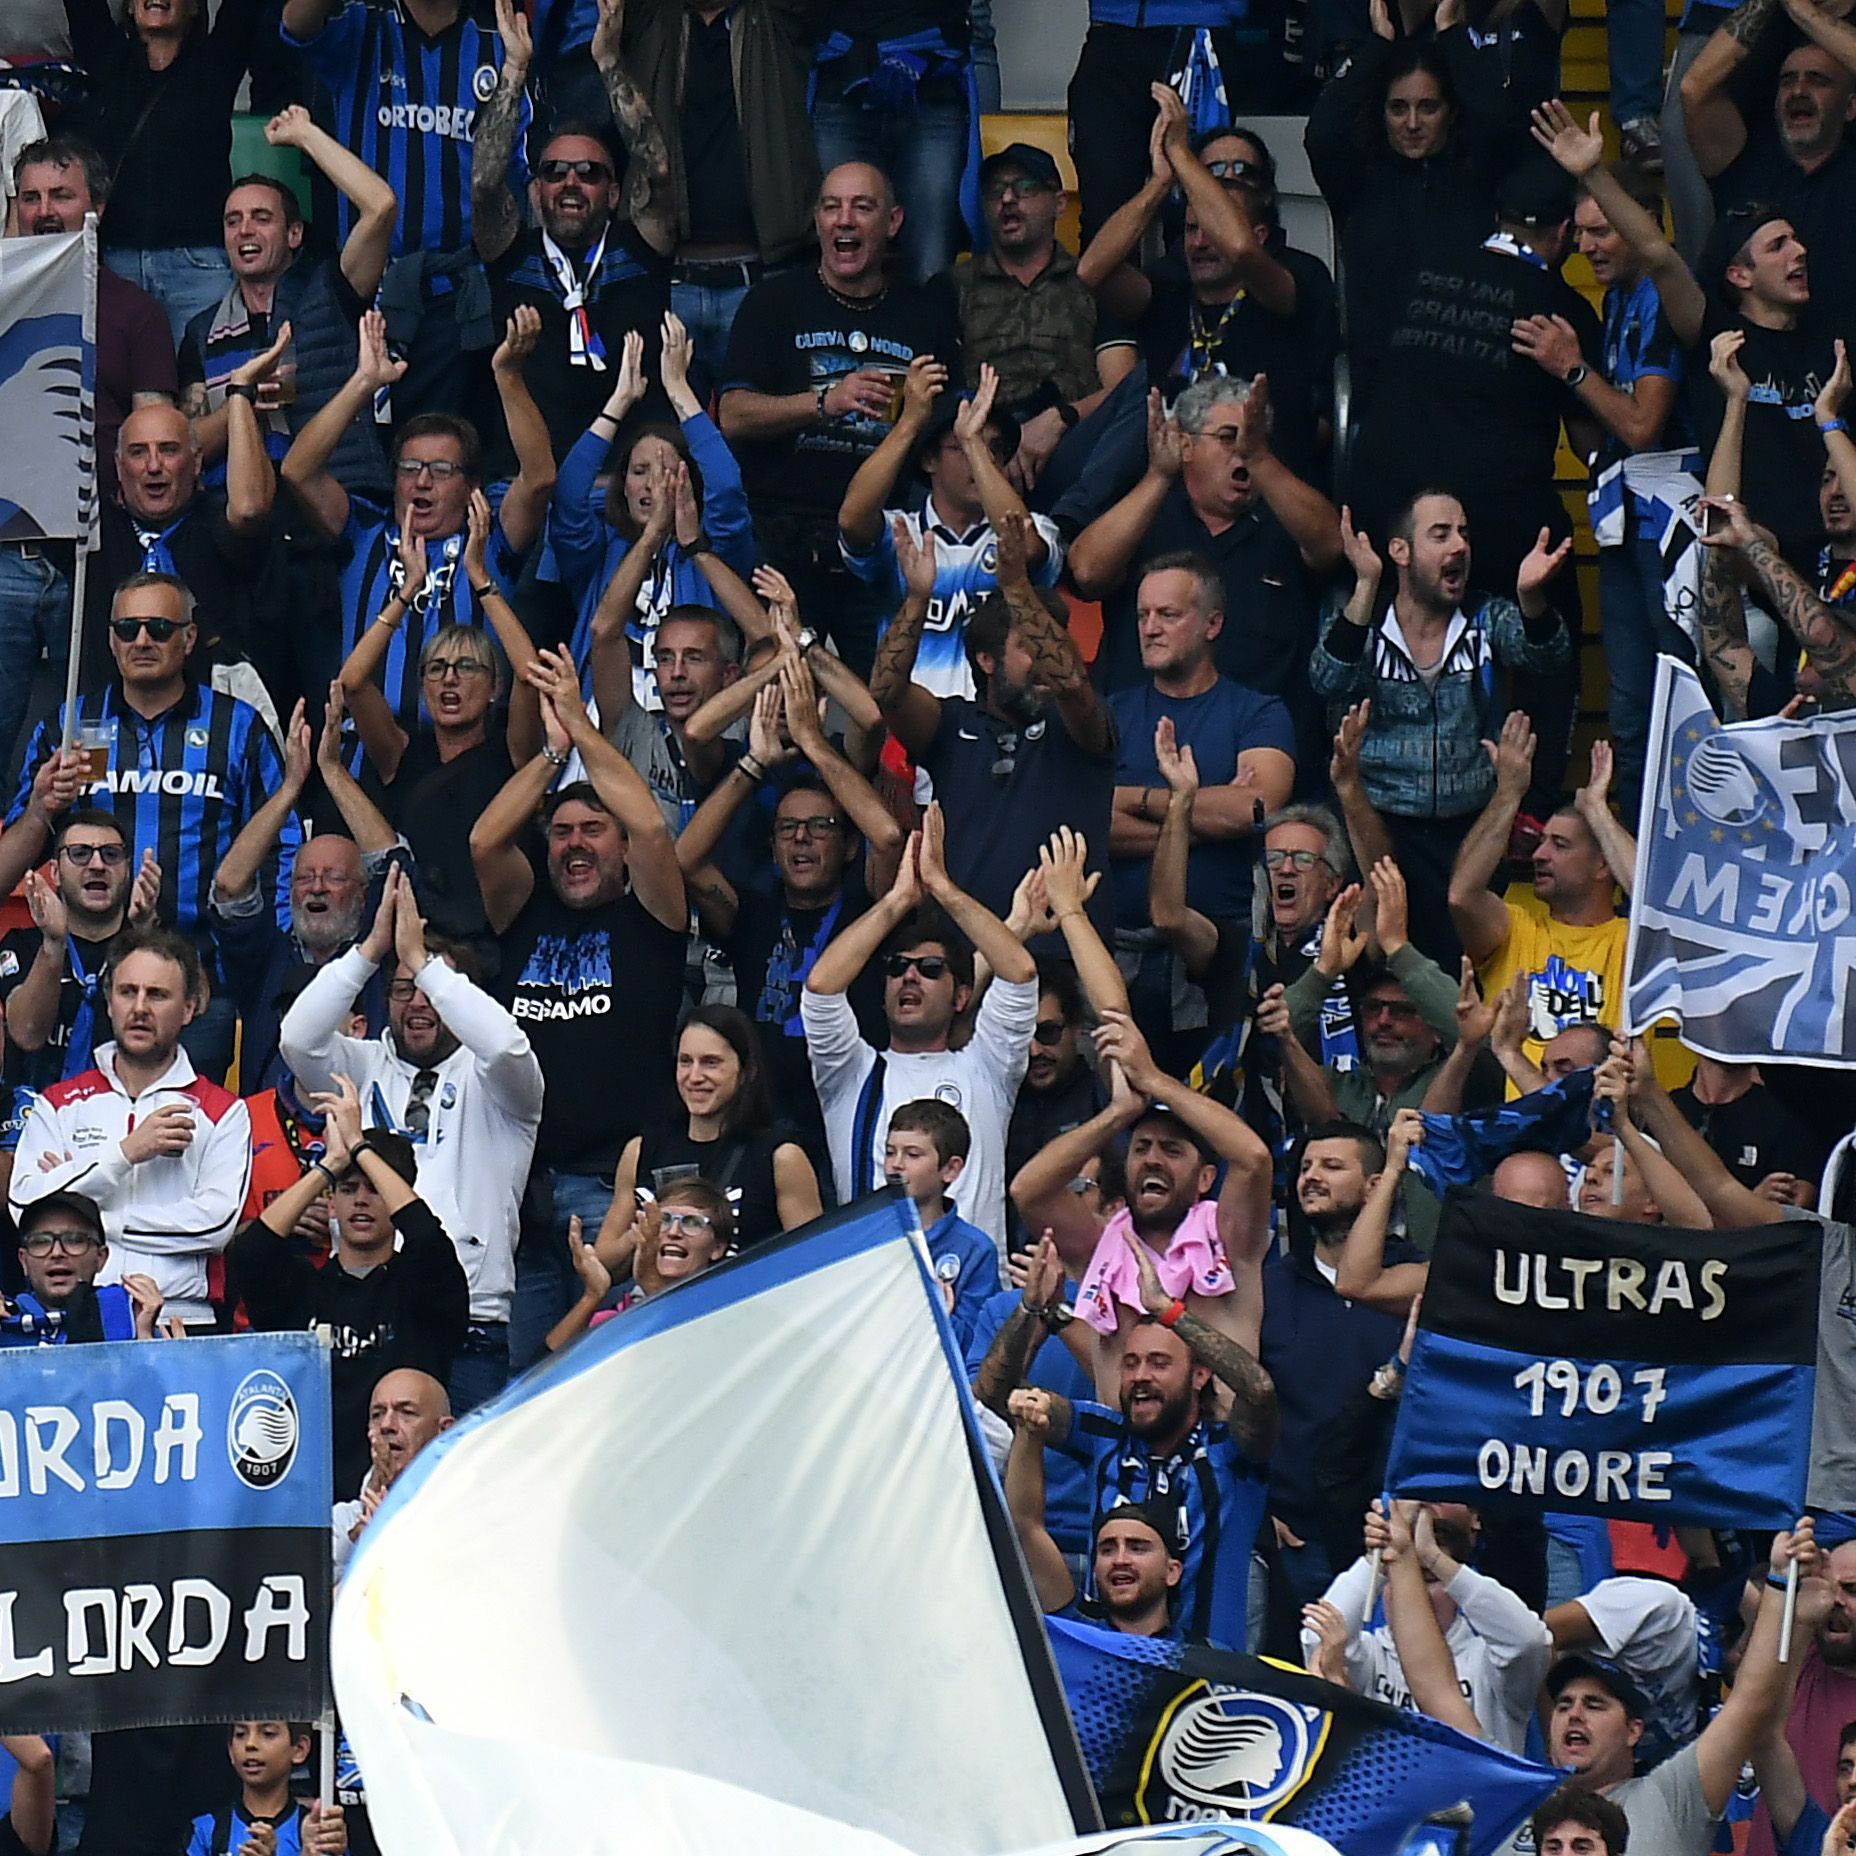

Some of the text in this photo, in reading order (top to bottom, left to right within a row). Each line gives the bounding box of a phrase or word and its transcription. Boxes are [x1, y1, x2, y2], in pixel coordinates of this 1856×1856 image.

[795, 332, 847, 352] CURVA
[81, 770, 227, 800] AMOIL
[1493, 1248, 1727, 1322] ULTRAS
[1513, 1359, 1668, 1424] 1907
[243, 1459, 280, 1479] 1907
[1478, 1442, 1673, 1503] ONORE
